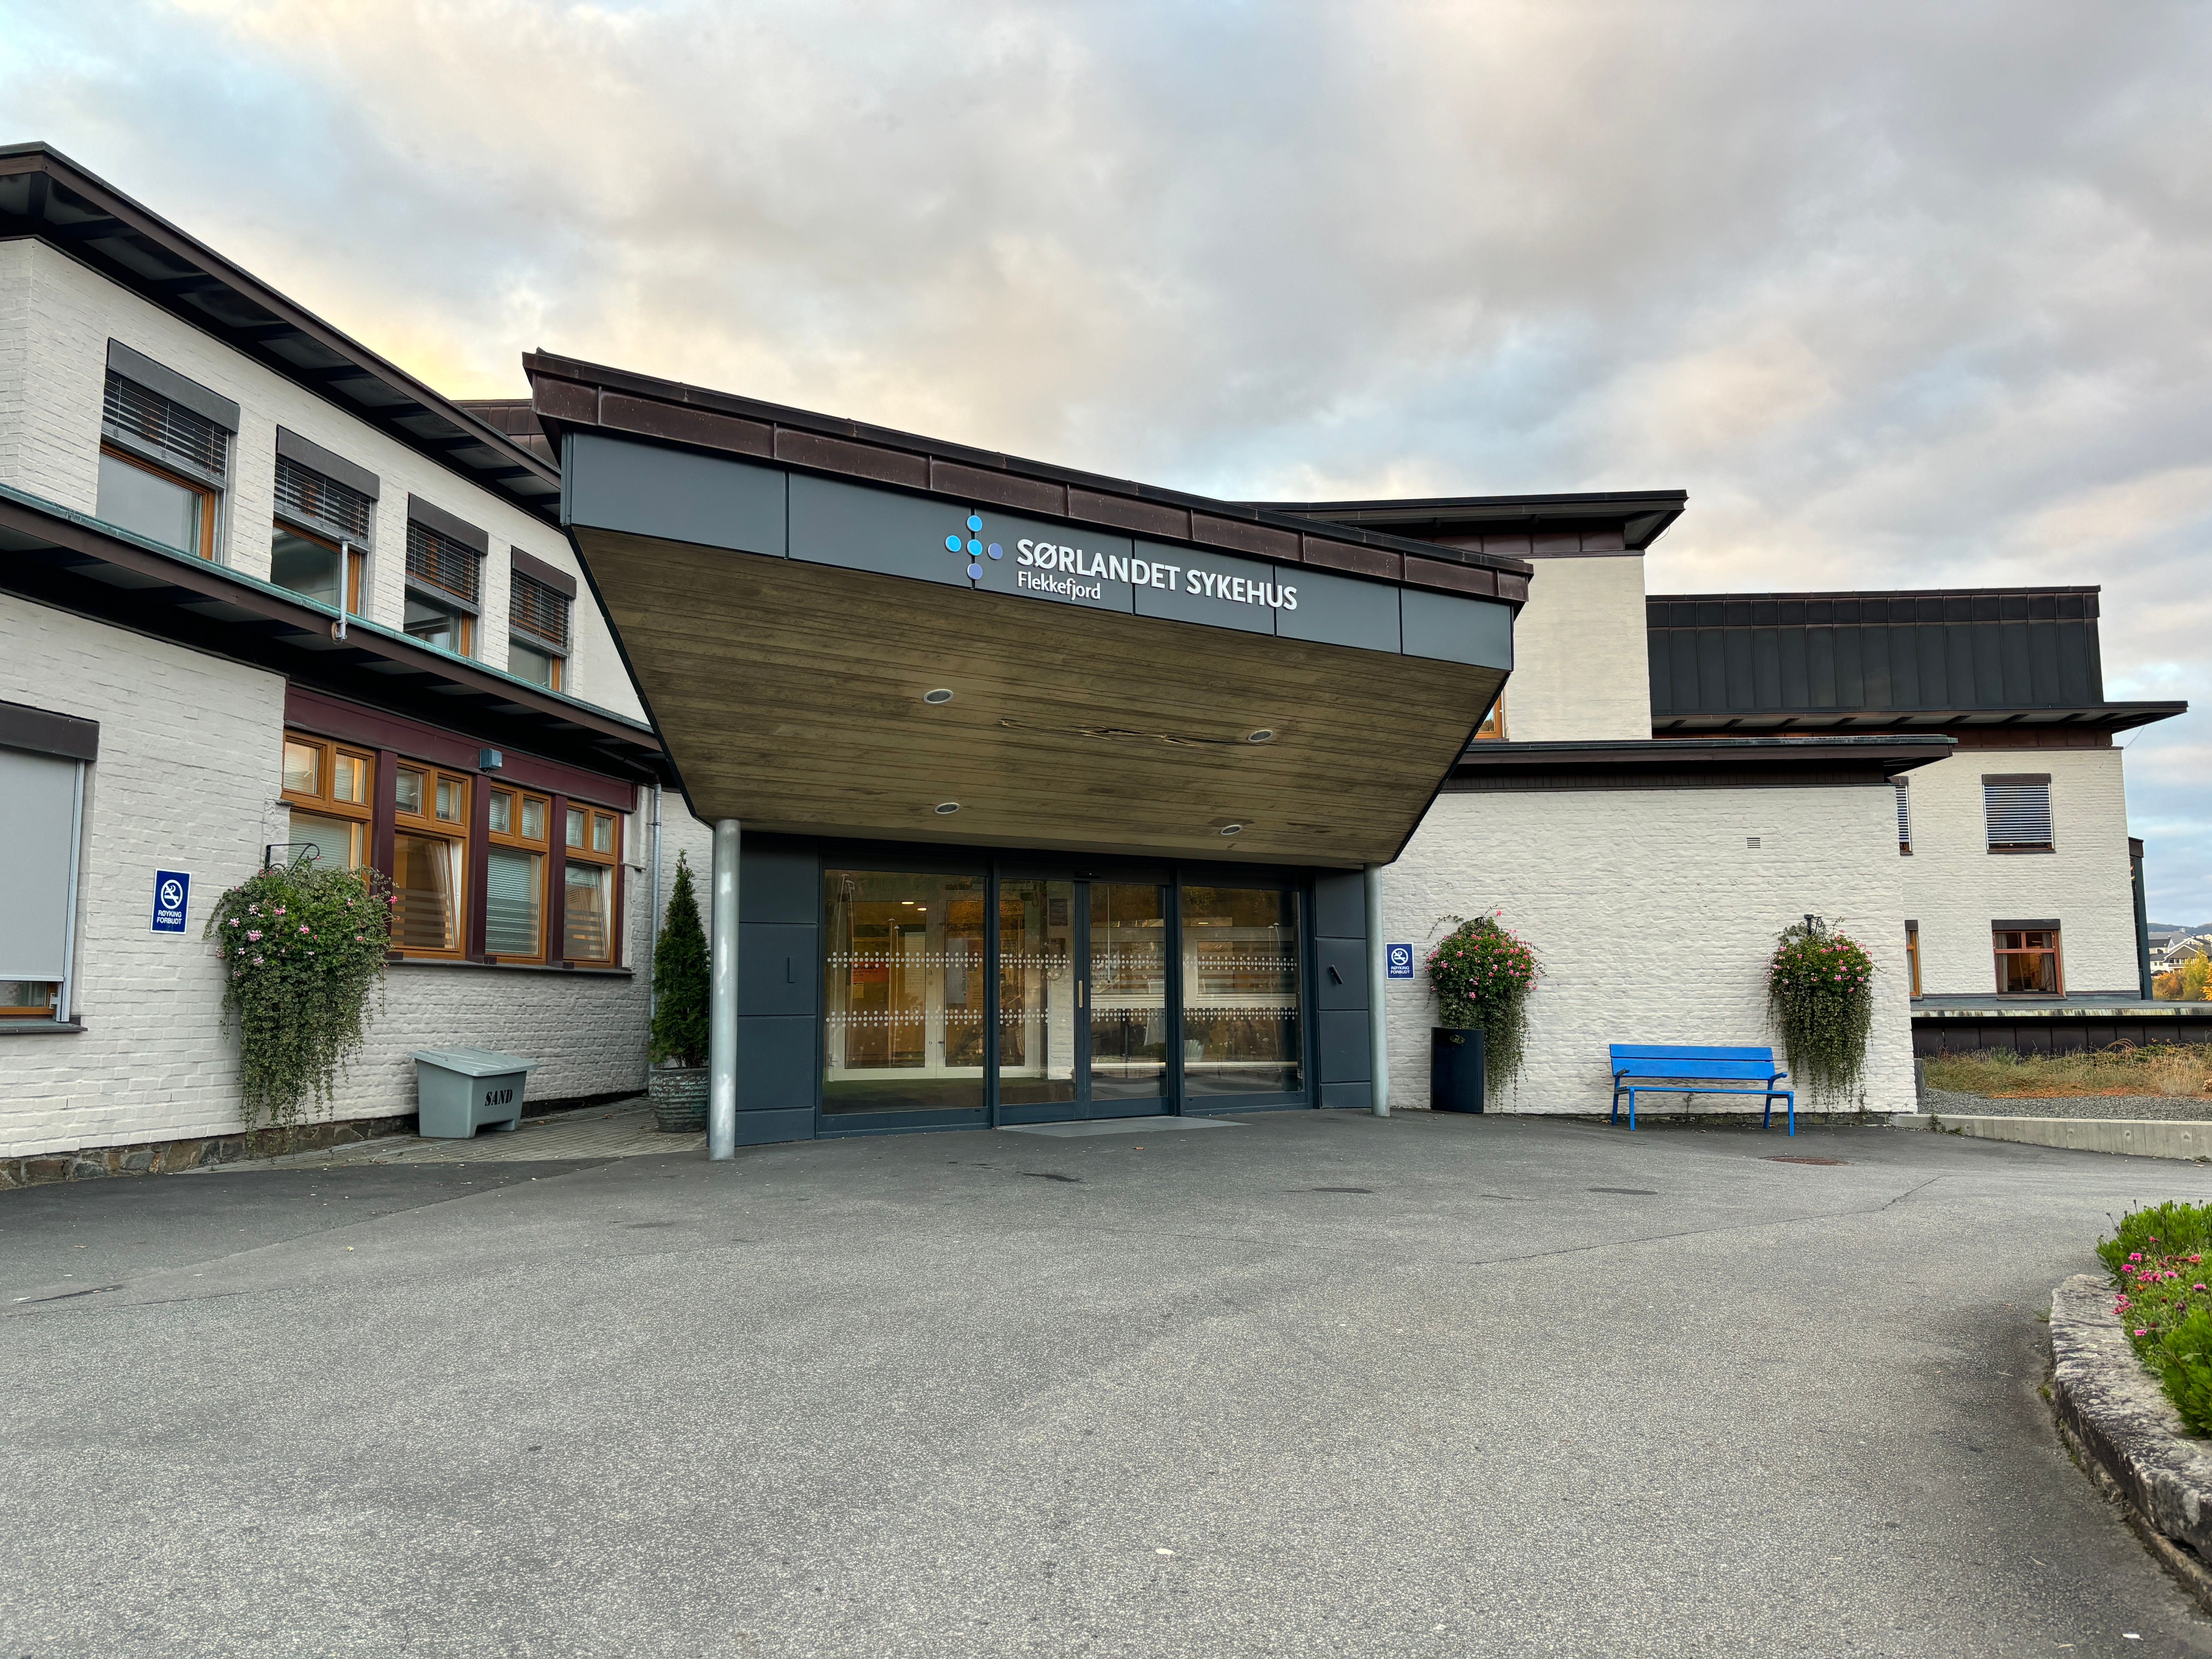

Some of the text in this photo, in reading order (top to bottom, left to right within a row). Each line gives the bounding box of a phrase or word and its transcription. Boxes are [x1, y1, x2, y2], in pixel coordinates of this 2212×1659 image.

[1016, 538, 1298, 611] SØRLANDET SYKEHUS
[1017, 571, 1101, 601] Flekkefjord
[158, 910, 182, 918] RØYKING
[485, 1089, 513, 1106] SAND
